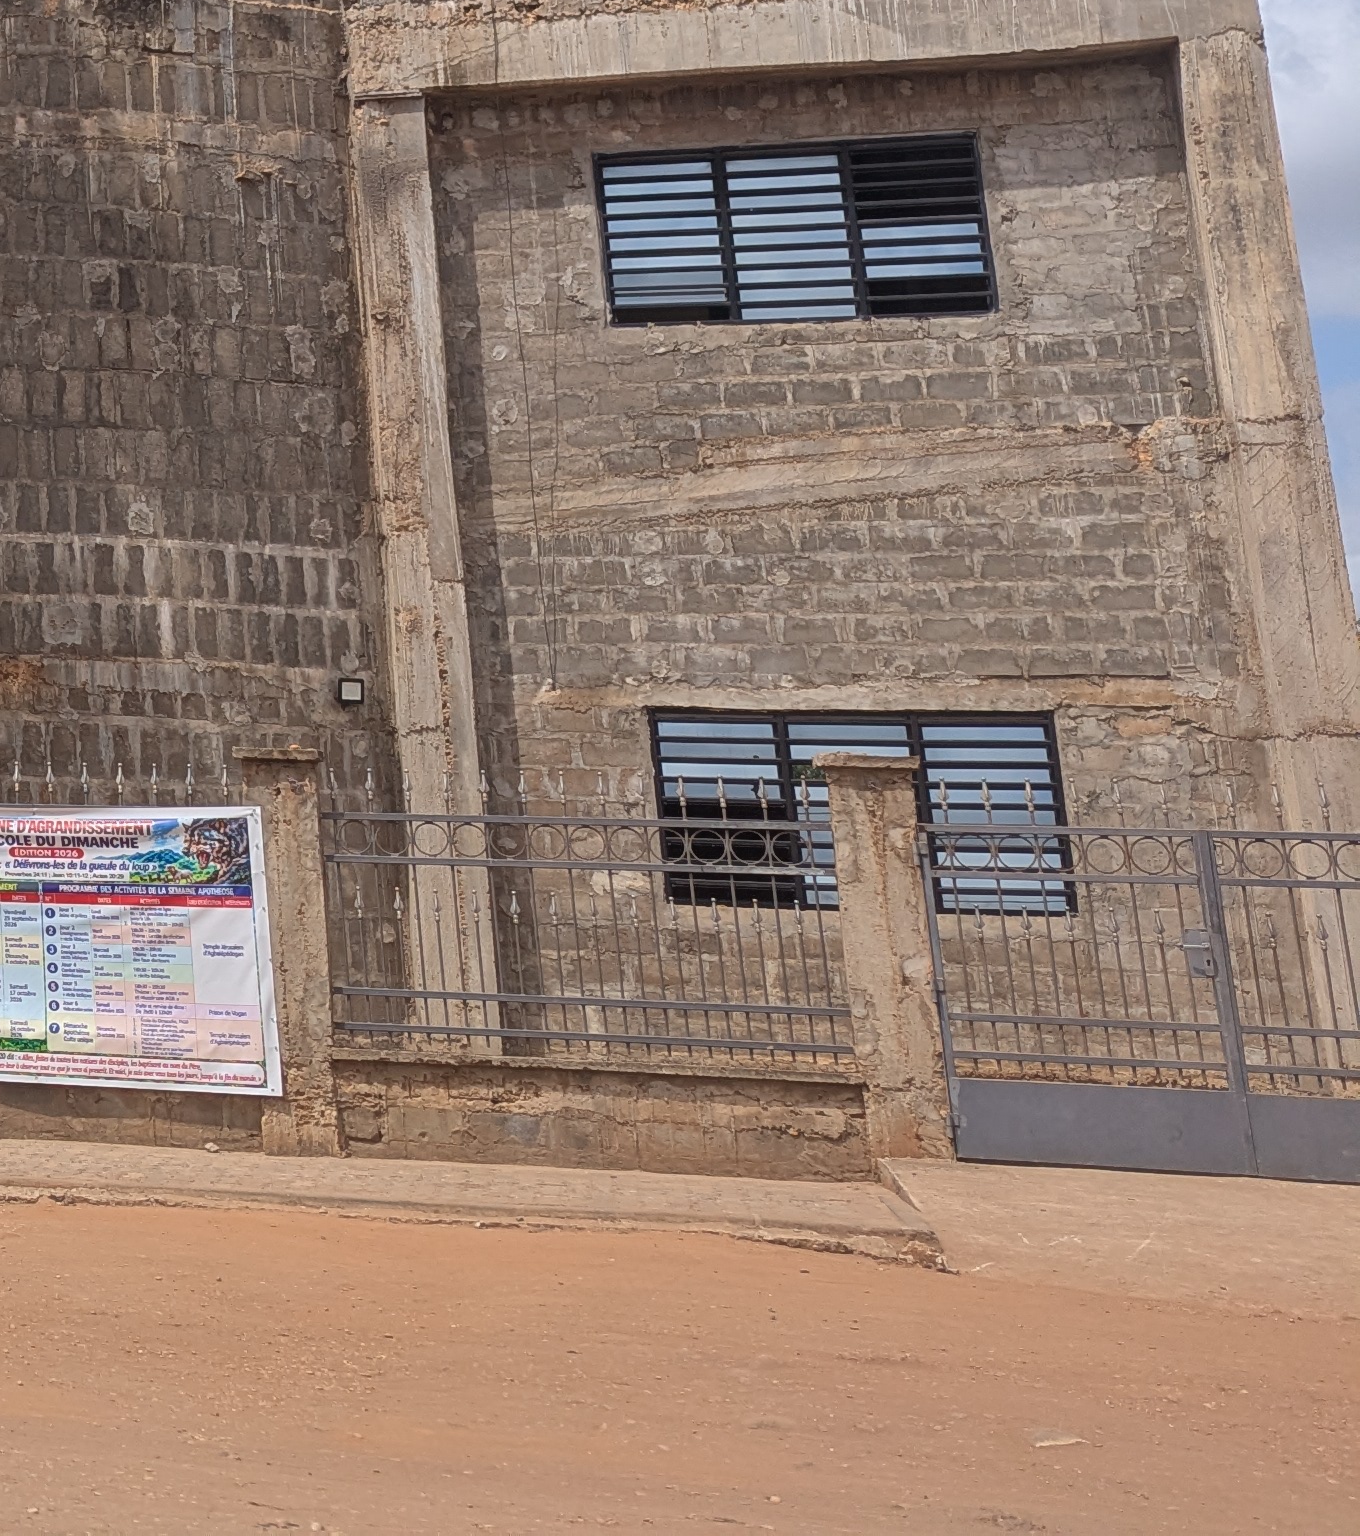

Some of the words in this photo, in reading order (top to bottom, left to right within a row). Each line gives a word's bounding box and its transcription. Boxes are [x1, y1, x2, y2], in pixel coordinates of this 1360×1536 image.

[17, 819, 153, 836] D'AGRANDISSEMENT
[36, 837, 56, 847] DU
[60, 836, 139, 849] DIMANCHE
[54, 849, 78, 858] 2026
[67, 861, 77, 869] de
[79, 861, 86, 870] la
[119, 862, 129, 871] du
[131, 863, 150, 873] loup
[59, 885, 99, 893] PROGRAMME
[100, 885, 113, 893] DES
[114, 885, 147, 894] ACTIVITÉS
[148, 886, 157, 894] DE
[48, 927, 54, 935] 2
